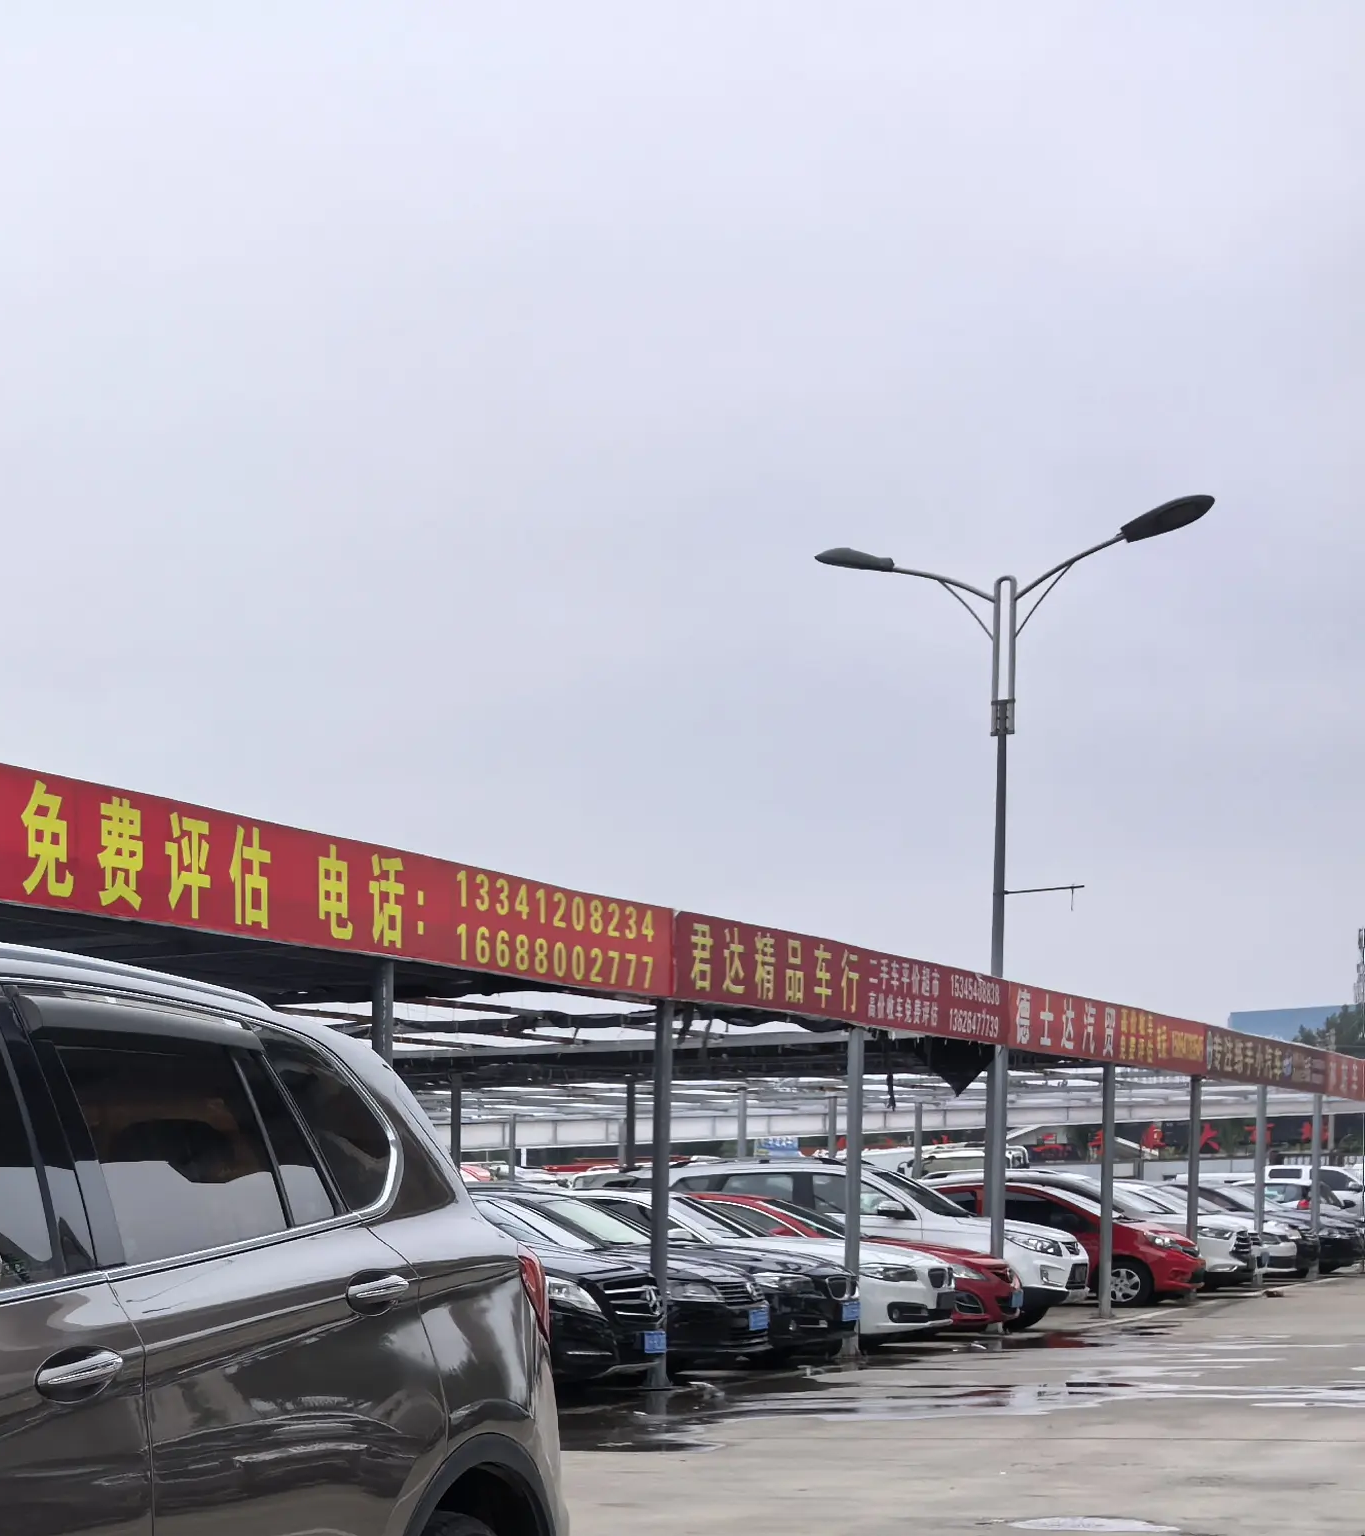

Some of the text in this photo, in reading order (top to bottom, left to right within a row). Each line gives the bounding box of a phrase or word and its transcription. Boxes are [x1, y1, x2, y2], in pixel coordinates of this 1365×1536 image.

[21, 780, 272, 930] 免费评估
[456, 870, 655, 943] 13341208234
[456, 923, 654, 989] 16688002777
[690, 923, 860, 1014] 君达精品车行
[1016, 987, 1116, 1058] 德士达汽贸
